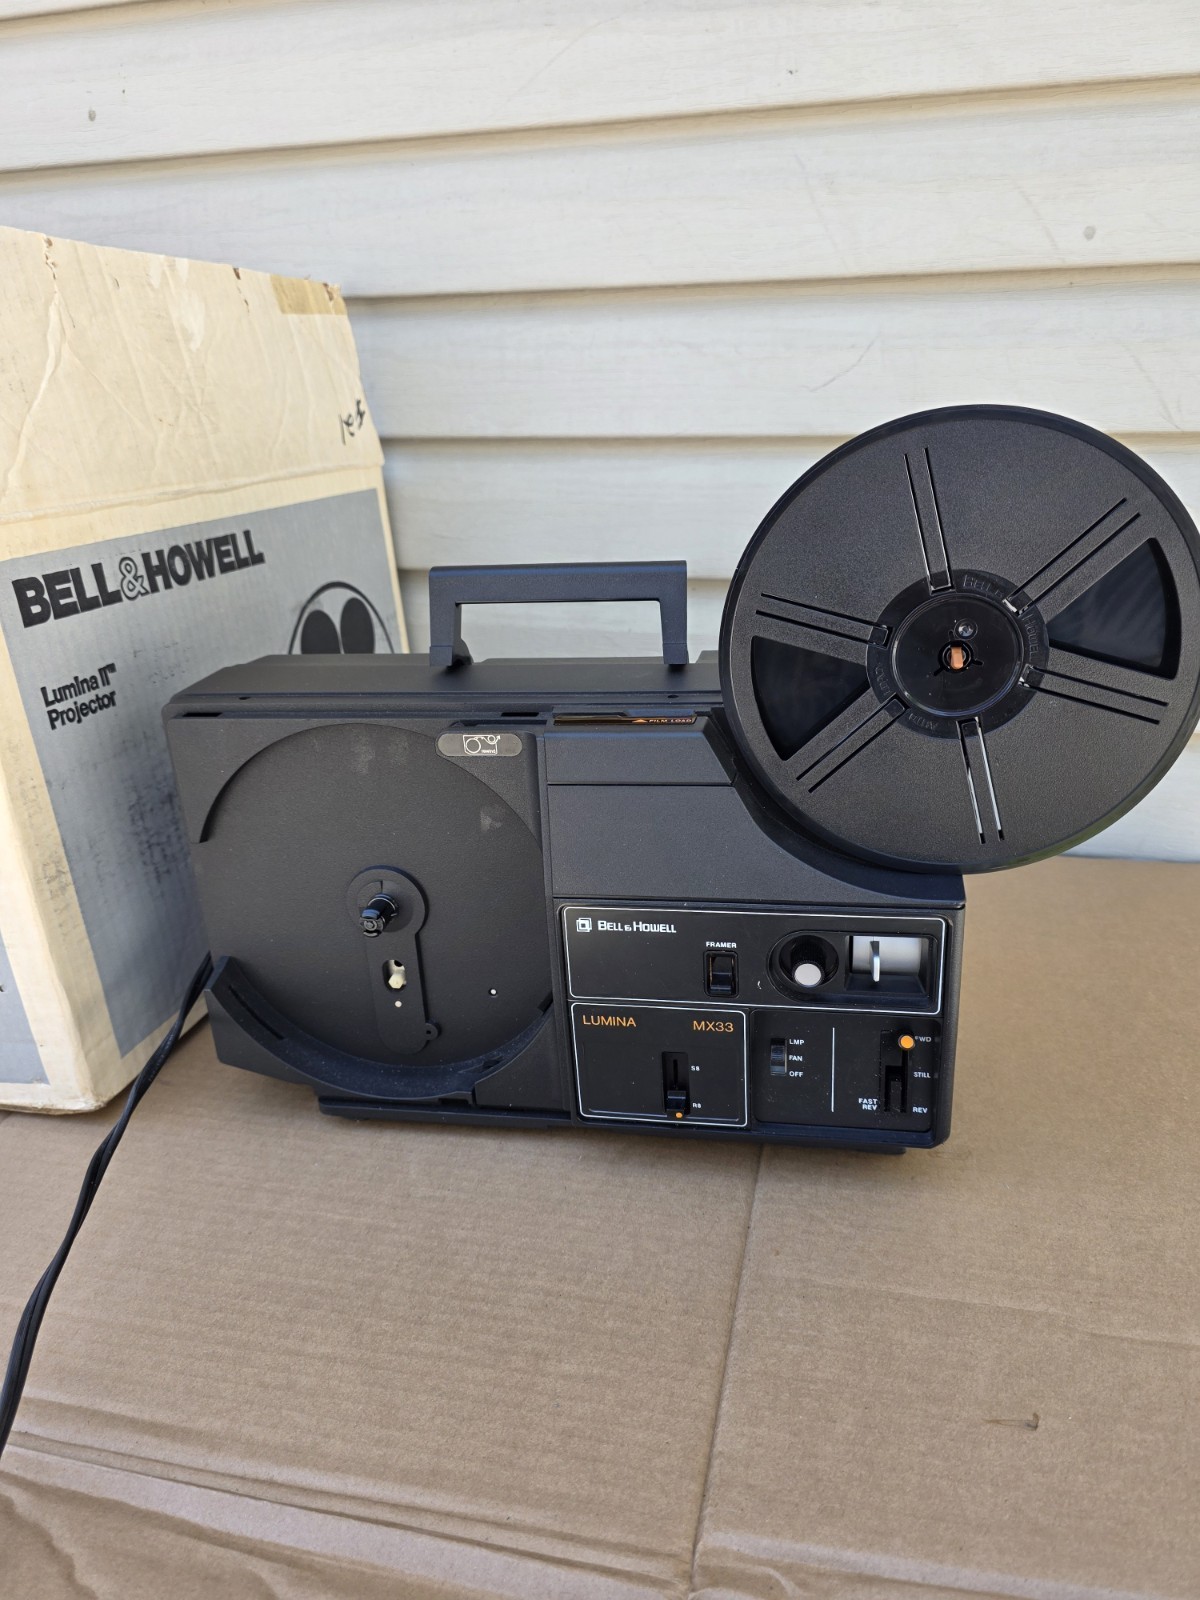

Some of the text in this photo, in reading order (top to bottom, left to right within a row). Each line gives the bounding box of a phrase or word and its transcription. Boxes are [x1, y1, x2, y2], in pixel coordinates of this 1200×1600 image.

[40, 675, 100, 708] Lumina
[46, 690, 117, 731] Projector
[705, 941, 737, 949] FRAMER
[582, 1015, 734, 1033] LUMINA MX33
[788, 1038, 805, 1046] LMP
[788, 1054, 803, 1062] FAN
[913, 1071, 931, 1079] STILL
[858, 1097, 878, 1105] FAST
[862, 1103, 878, 1111] REV
[912, 1106, 928, 1114] REV
